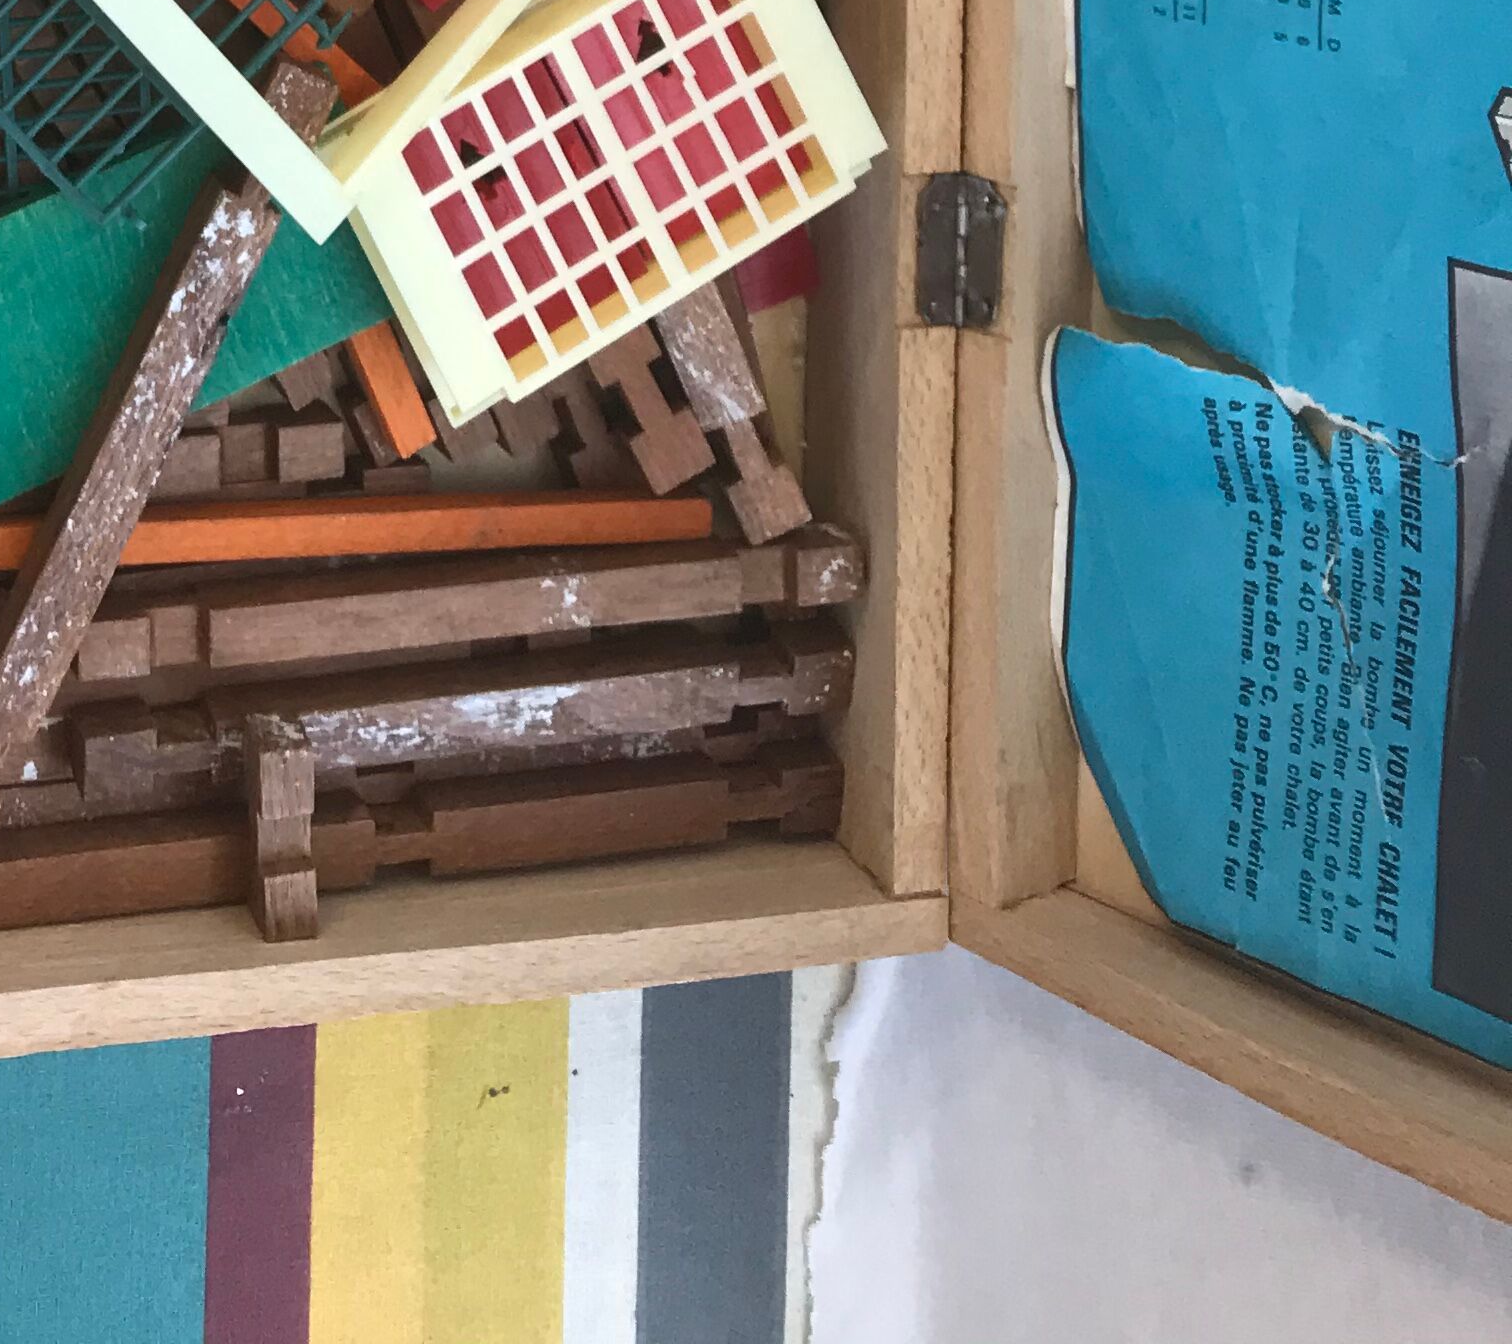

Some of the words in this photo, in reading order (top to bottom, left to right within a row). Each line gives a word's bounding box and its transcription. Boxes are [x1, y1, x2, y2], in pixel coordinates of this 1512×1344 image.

[1229, 400, 1246, 412] à
[1255, 403, 1273, 432] Ne
[1201, 397, 1225, 448] après
[1213, 455, 1239, 507] usage.
[1227, 420, 1263, 504] proximité
[1253, 436, 1273, 469] pas
[1264, 473, 1287, 541] stocker
[1299, 492, 1315, 513] de
[1244, 510, 1263, 570] d'une
[1266, 544, 1285, 557] à
[1302, 521, 1318, 551] 30
[1300, 559, 1317, 572] à
[1371, 509, 1389, 607] séjourner
[1262, 561, 1282, 605] plus
[1299, 582, 1316, 613] 40
[1240, 580, 1258, 664] flamme.
[1264, 610, 1280, 636] de
[1296, 620, 1309, 656] cm.
[1371, 622, 1386, 640] la
[1317, 616, 1335, 676] petits
[1391, 566, 1422, 730] FACILEMENT
[1239, 677, 1256, 707] Ne
[1293, 667, 1310, 692] de
[1233, 713, 1251, 753] pas
[1258, 714, 1273, 742] ne
[1289, 703, 1305, 755] votre
[1310, 684, 1331, 750] coups,
[1253, 746, 1270, 786] pas
[1332, 718, 1351, 780] agiter
[1357, 747, 1371, 773] un
[1229, 758, 1249, 813] jeter
[1310, 762, 1326, 780] la
[1383, 744, 1410, 828] VOTRE
[1281, 763, 1302, 831] chalet.
[1227, 820, 1241, 847] au
[1302, 788, 1324, 862] bombe
[1326, 788, 1344, 848] avant
[1346, 790, 1368, 879] moment
[1245, 792, 1269, 902] pulvériser
[1223, 857, 1240, 891] feu
[1323, 855, 1340, 881] de
[1298, 869, 1313, 924] étant
[1321, 890, 1337, 934] s'en
[1345, 894, 1362, 908] à
[1374, 842, 1401, 943] CHALET
[1344, 924, 1361, 944] la
